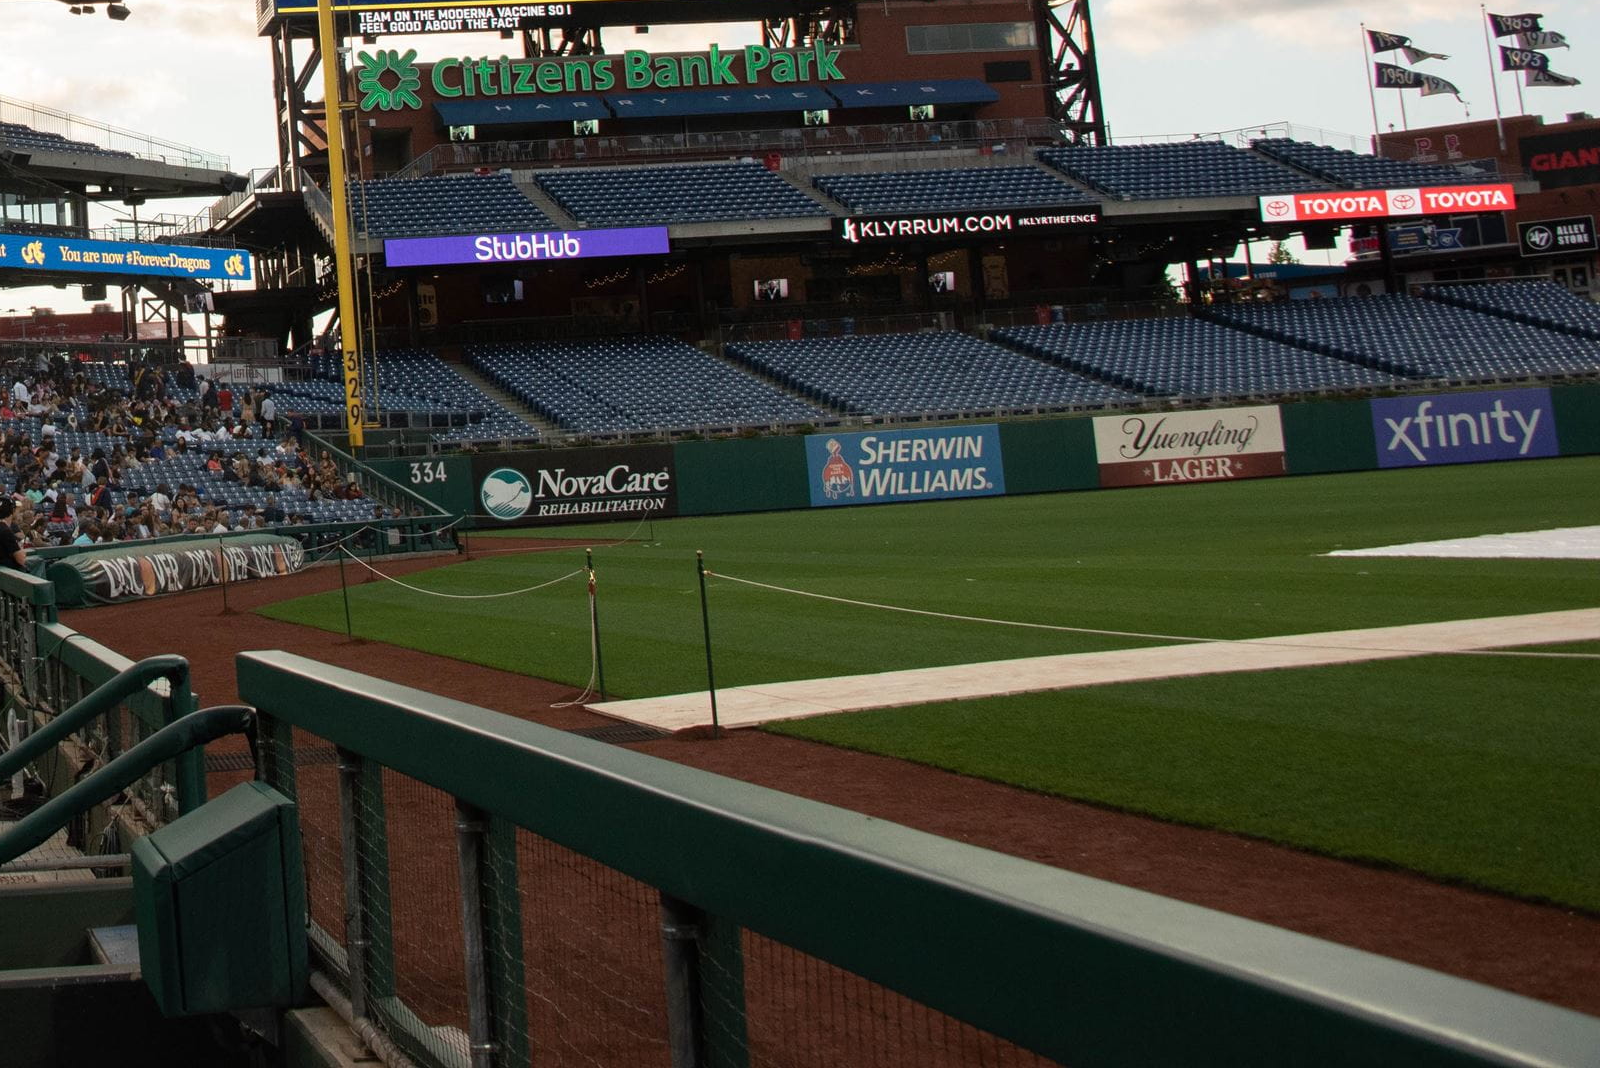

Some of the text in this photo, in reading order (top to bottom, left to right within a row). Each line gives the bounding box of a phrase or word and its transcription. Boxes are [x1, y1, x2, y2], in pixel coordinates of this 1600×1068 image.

[359, 4, 571, 23] TEAM ON THE MODERNA VACCINE SO I
[359, 17, 520, 33] FEEL GOOD ABOUT THE FACT
[432, 38, 846, 97] Citizens Bank Park
[1507, 51, 1540, 67] 1993
[1382, 68, 1415, 84] 1950
[1530, 146, 1600, 172] GIAN
[1299, 190, 1508, 215] TOYOTA TOYOTA
[861, 214, 1097, 237] KLYRRUM.COM #KLYRTHEFENCE
[1557, 224, 1585, 236] ALLEY
[475, 233, 578, 261] StubHub
[1557, 233, 1589, 245] STORE
[59, 246, 81, 262] You
[83, 250, 100, 263] are
[102, 252, 123, 265] now
[126, 250, 211, 273] #ForeverDragons
[345, 350, 361, 426] 329
[1119, 415, 1258, 459] Yuengling
[1384, 399, 1541, 462] xfinity
[858, 435, 983, 465] SHERWIN
[410, 461, 447, 484] 334
[535, 465, 670, 498] NovaCare
[858, 467, 987, 497] WILLIAMS
[1152, 457, 1234, 482] LAGER
[538, 497, 667, 516] REHABILITATION
